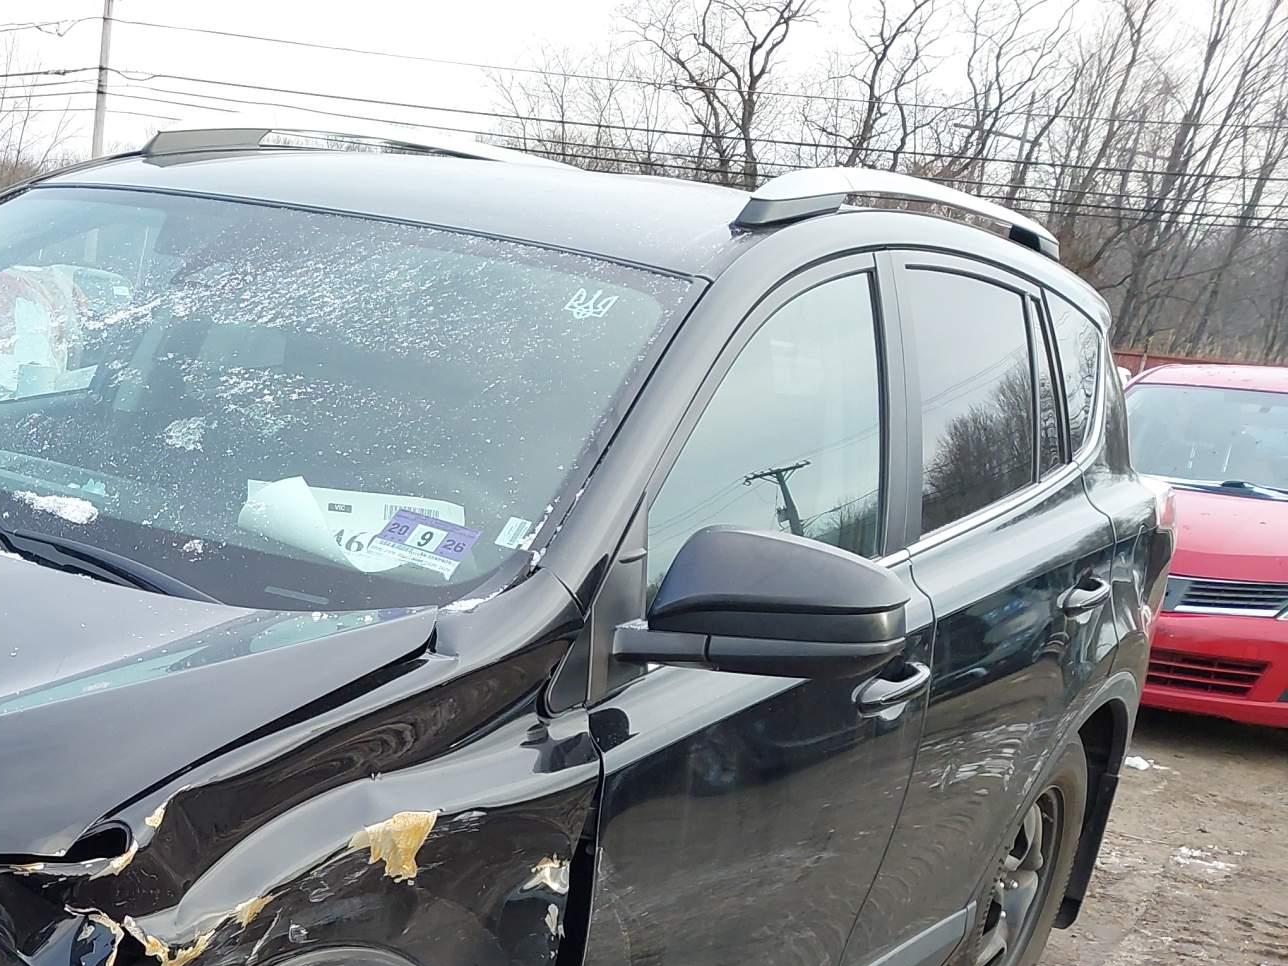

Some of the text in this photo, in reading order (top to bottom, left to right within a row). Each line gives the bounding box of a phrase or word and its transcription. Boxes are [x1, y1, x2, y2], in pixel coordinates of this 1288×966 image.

[388, 522, 410, 536] 20
[417, 531, 434, 548] 9
[442, 539, 466, 553] 26
